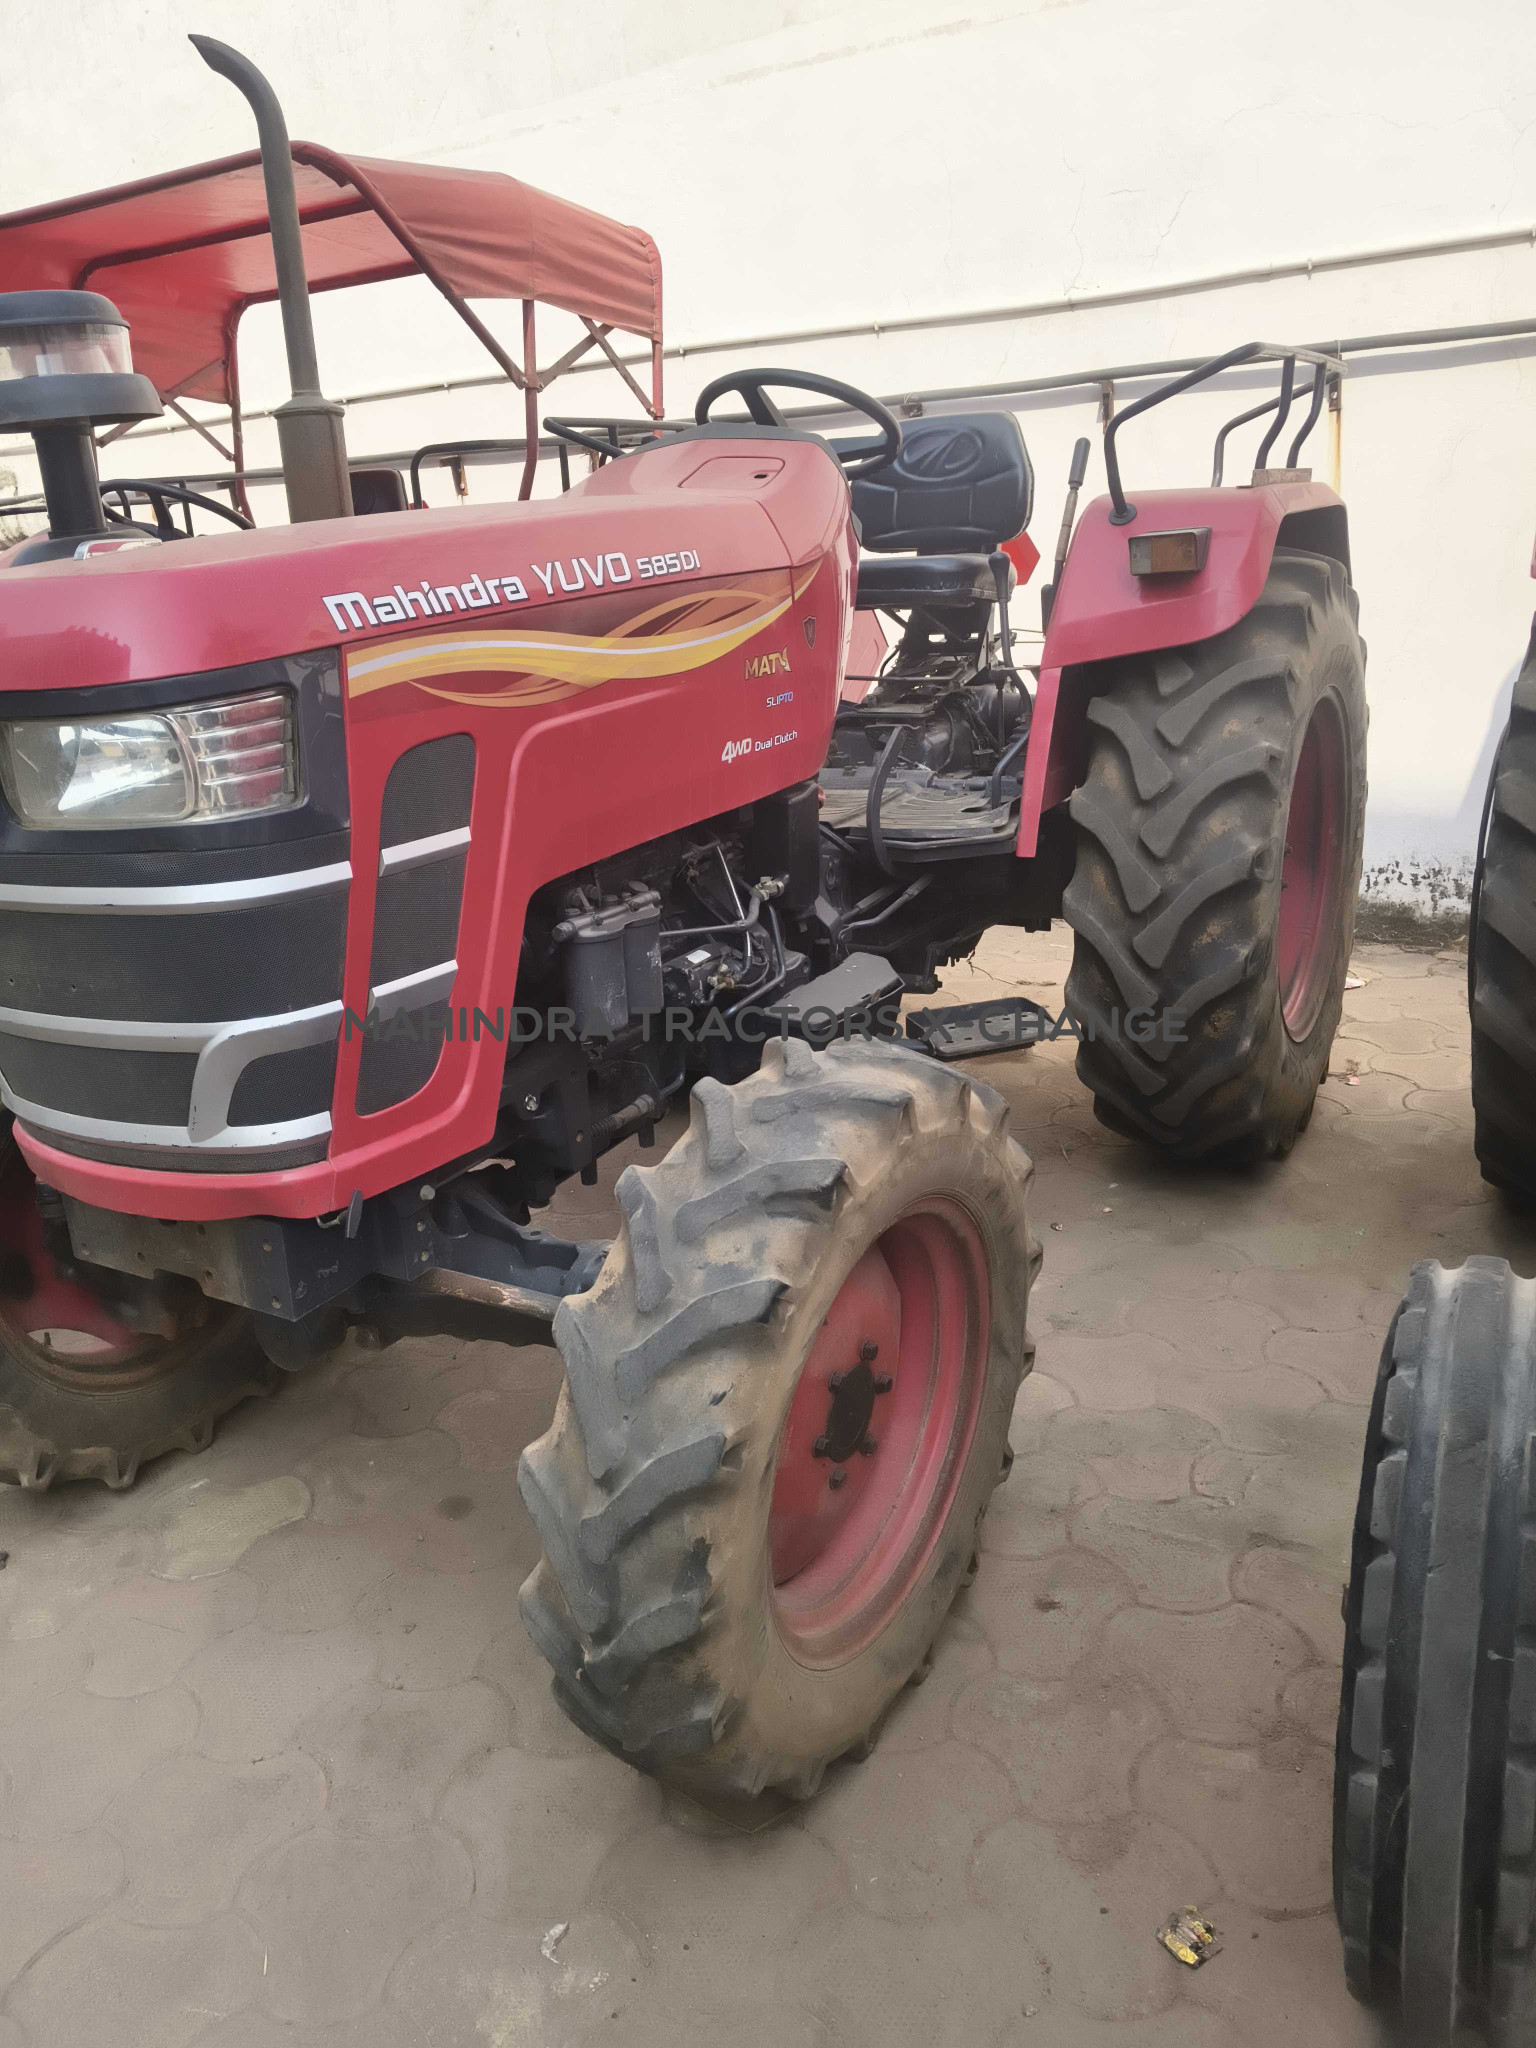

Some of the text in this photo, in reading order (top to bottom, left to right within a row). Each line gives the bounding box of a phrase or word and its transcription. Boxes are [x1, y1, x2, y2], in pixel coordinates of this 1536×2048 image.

[322, 573, 529, 632] Mahindra
[531, 552, 632, 596] YUVO
[721, 729, 798, 763] 4WD Dual Clutch
